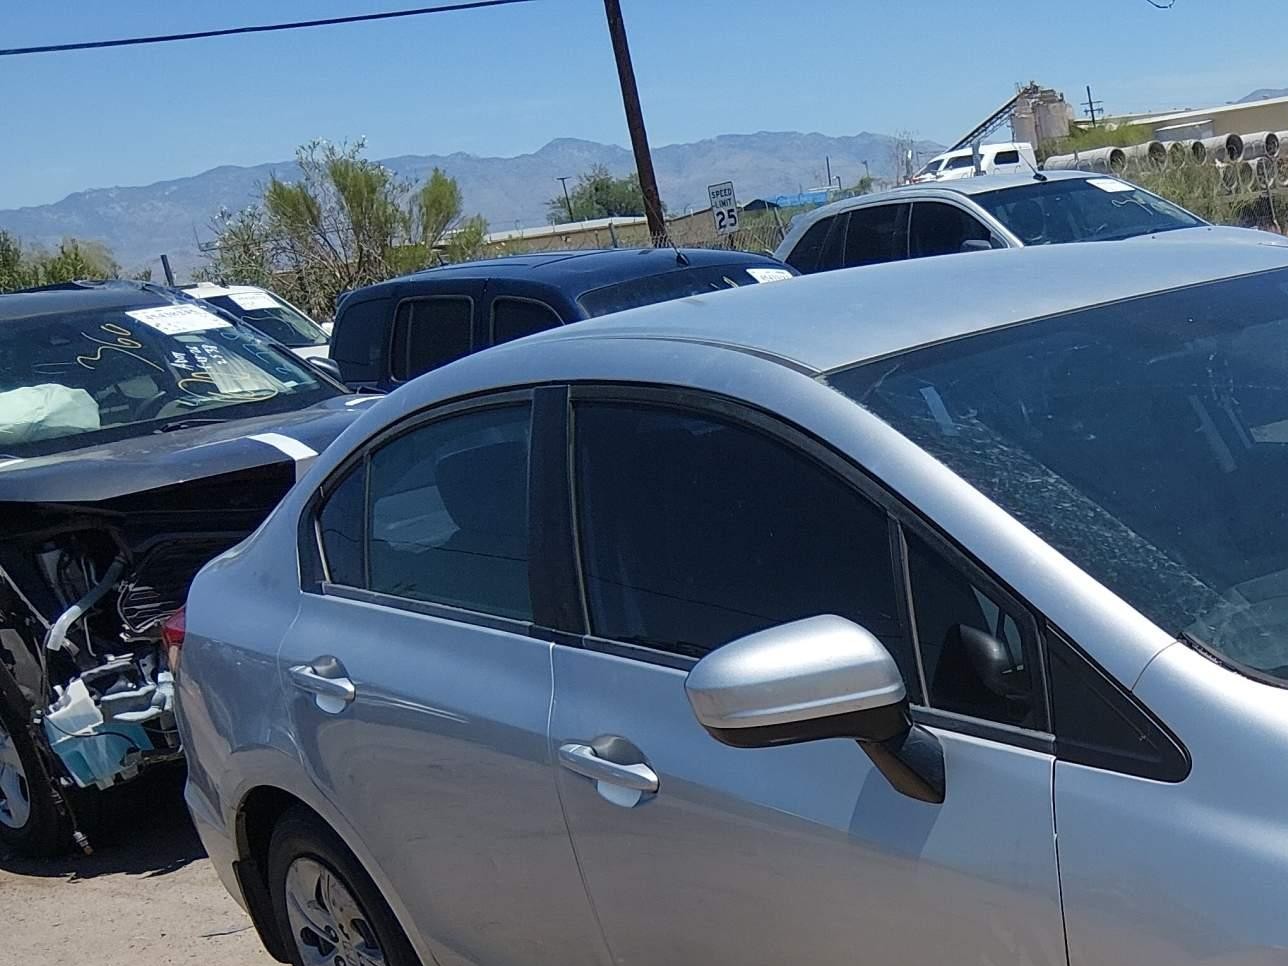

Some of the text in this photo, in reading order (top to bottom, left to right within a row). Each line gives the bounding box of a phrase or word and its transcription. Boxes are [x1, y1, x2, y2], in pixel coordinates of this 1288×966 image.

[711, 188, 732, 199] SPEED
[714, 198, 732, 208] LIMIT
[716, 208, 737, 230] 25
